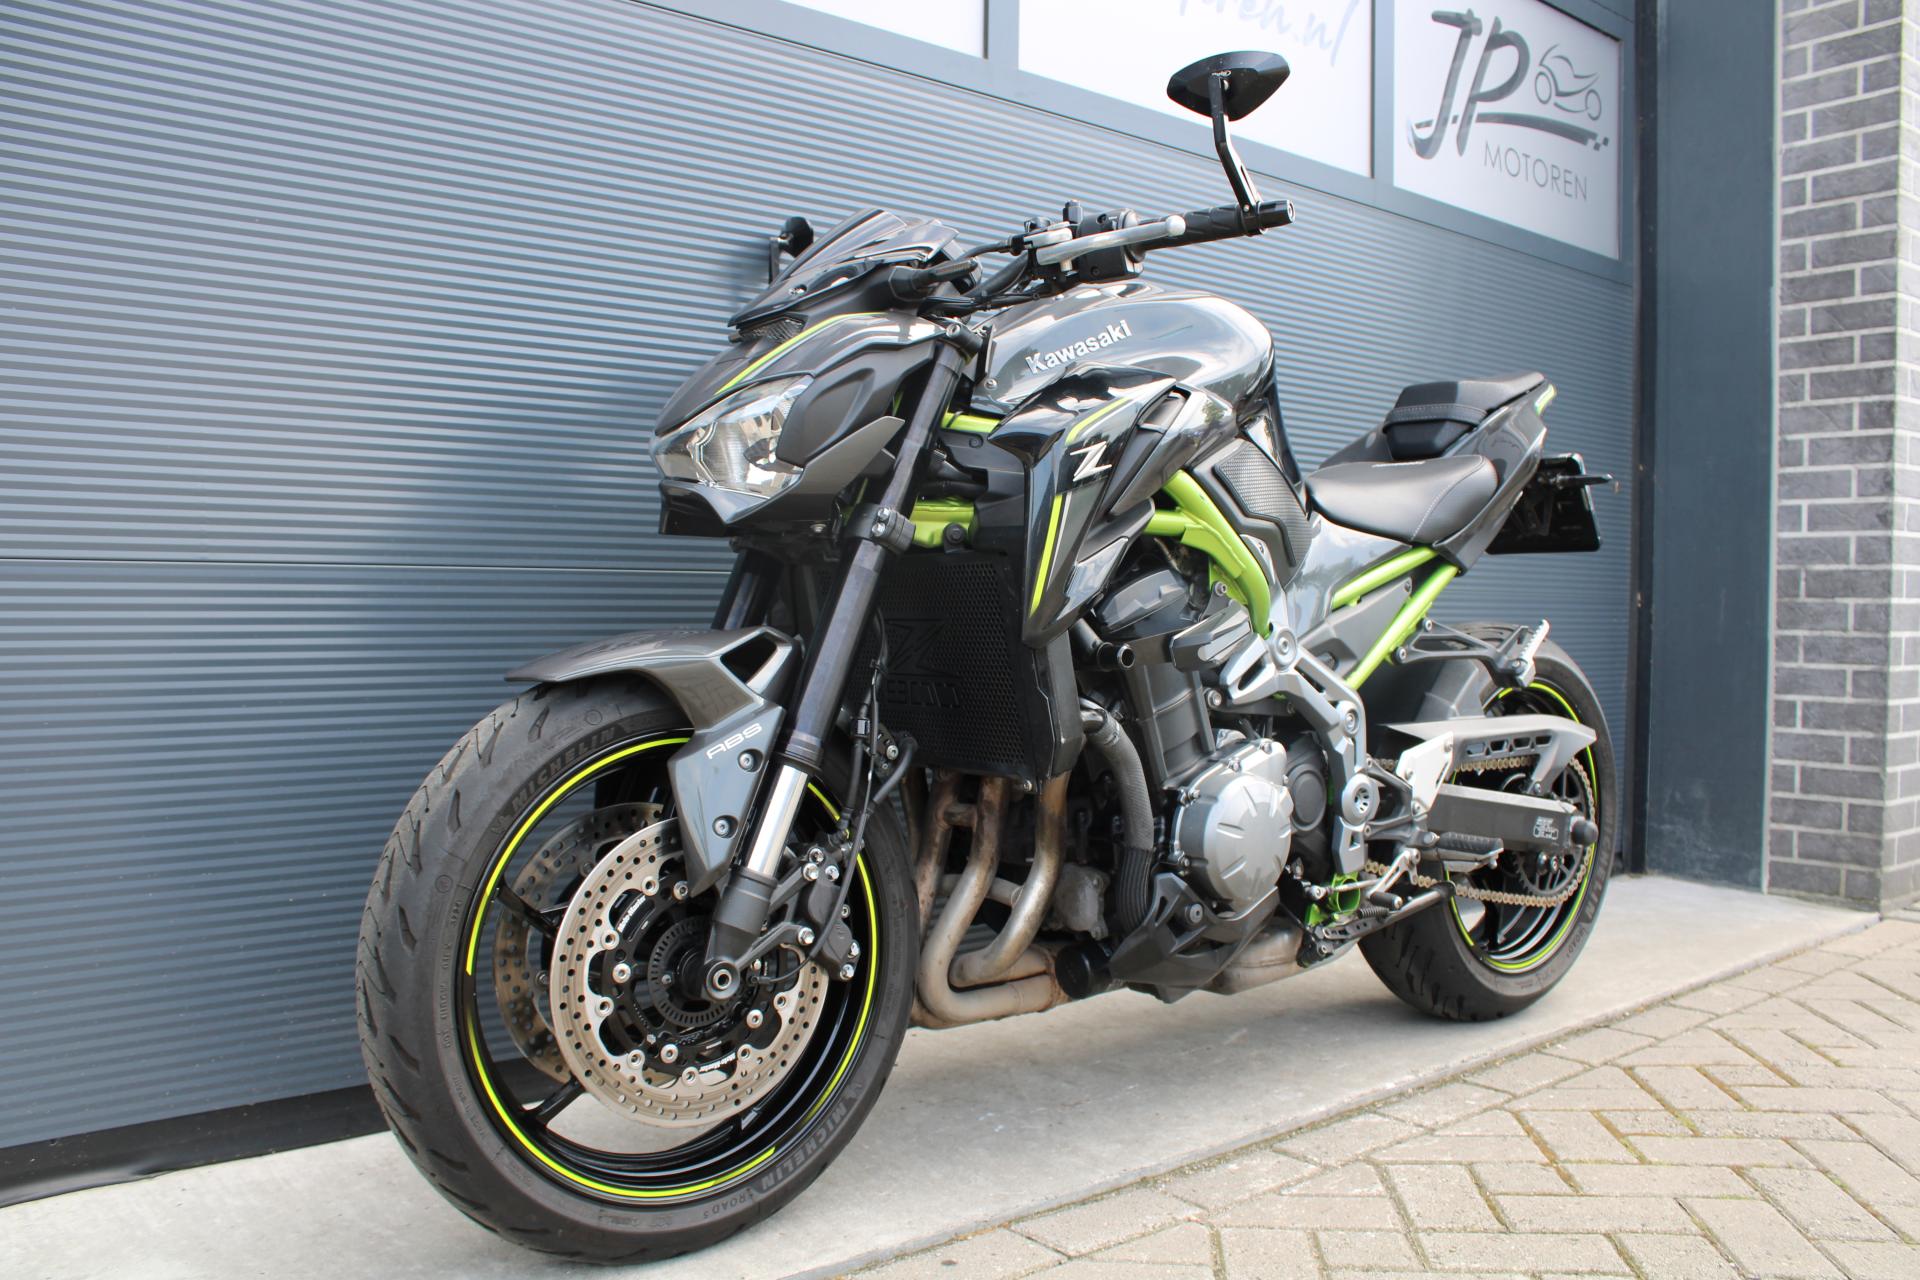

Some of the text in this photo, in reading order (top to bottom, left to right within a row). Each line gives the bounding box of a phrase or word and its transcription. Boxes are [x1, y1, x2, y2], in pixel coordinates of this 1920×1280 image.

[1407, 8, 1530, 160] JP
[1483, 141, 1588, 200] MOTOREN
[1025, 320, 1132, 374] Kawasaki
[1069, 441, 1112, 482] Z
[511, 726, 616, 812] MICHELIN
[706, 723, 762, 759] ABS
[761, 1101, 848, 1191] MICHELIN
